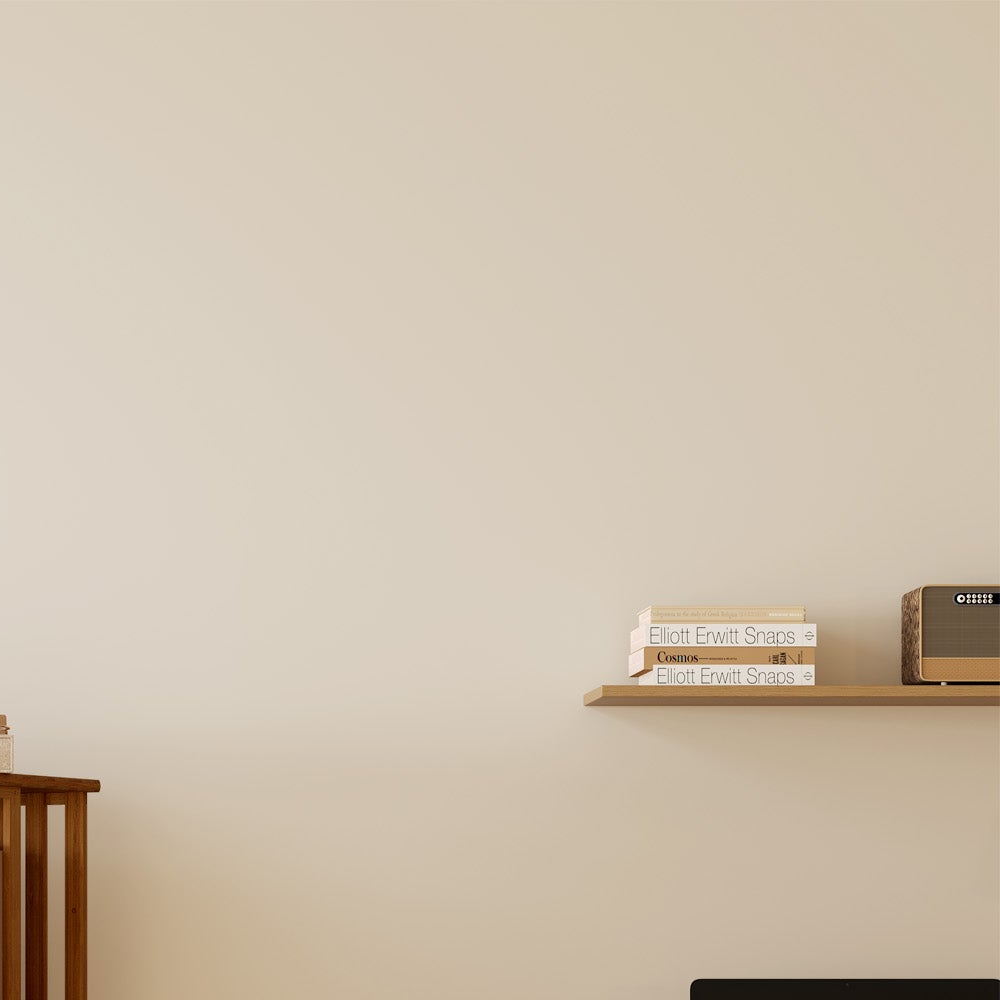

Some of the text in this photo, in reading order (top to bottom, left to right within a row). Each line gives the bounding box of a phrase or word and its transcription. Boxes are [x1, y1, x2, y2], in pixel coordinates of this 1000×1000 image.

[650, 626, 796, 647] Elliott Erwitt Snaps
[657, 651, 699, 663] Cosmos
[657, 668, 795, 686] Elliott Erwitt Snaps
